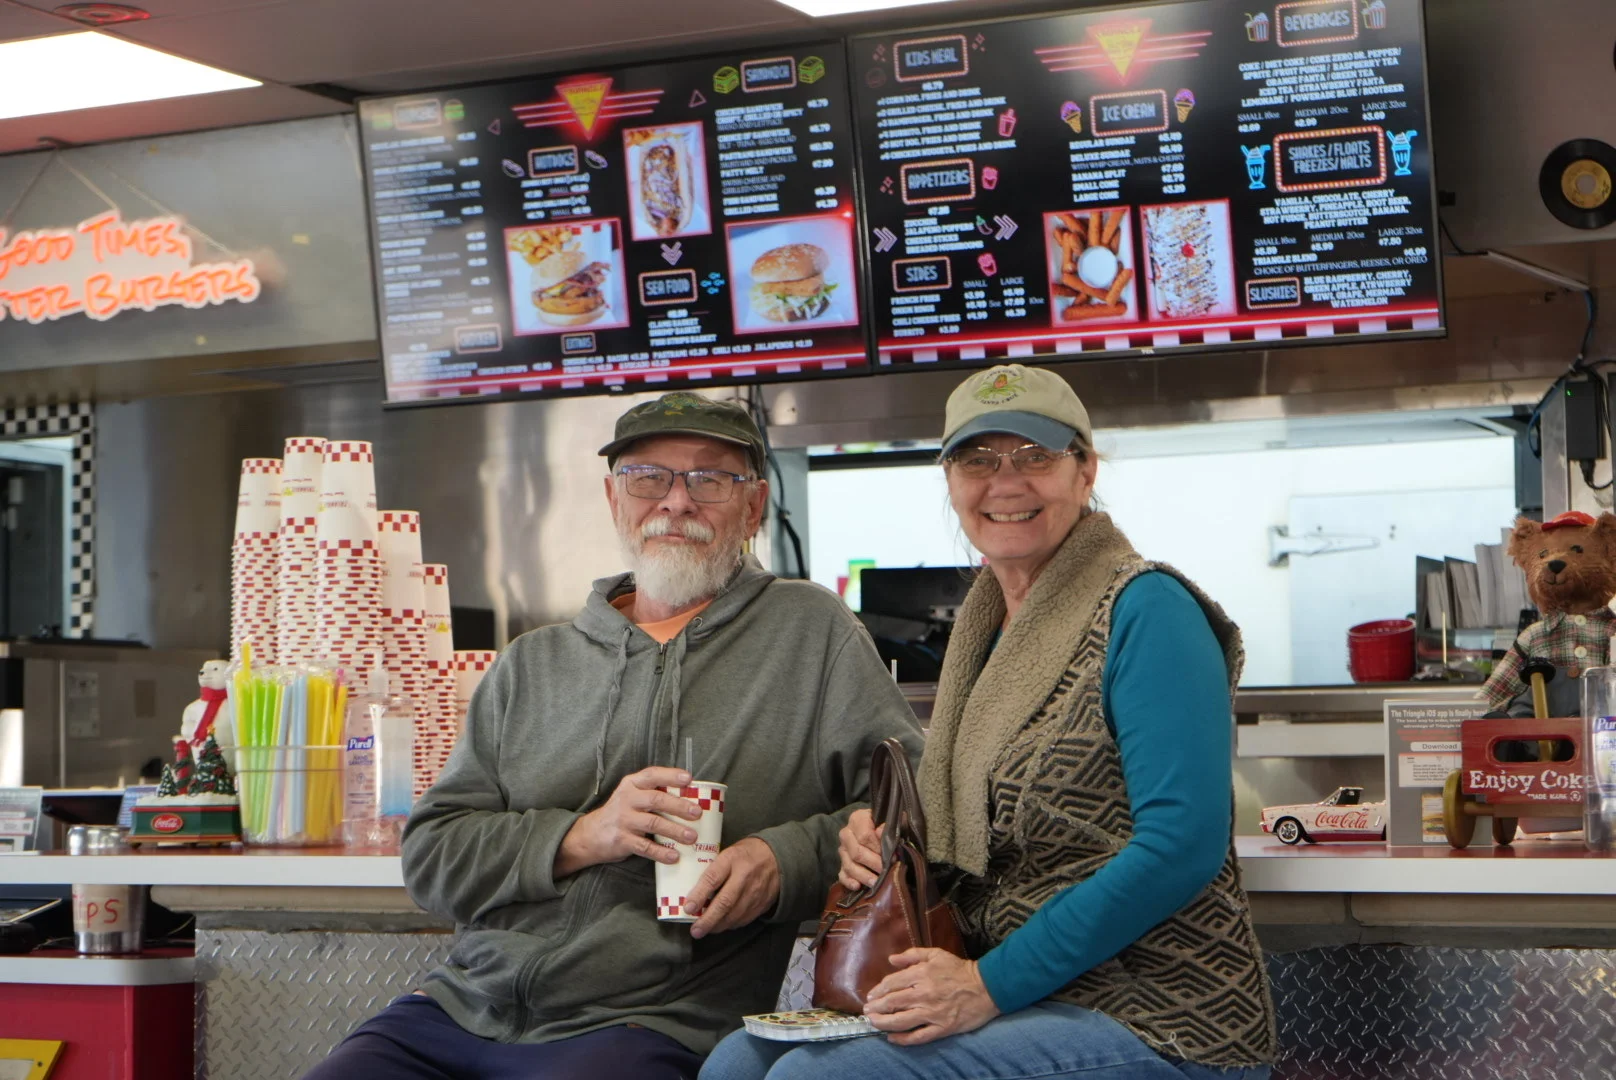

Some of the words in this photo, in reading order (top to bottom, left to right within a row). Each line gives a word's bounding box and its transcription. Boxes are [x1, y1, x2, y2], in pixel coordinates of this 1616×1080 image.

[1284, 10, 1350, 32] BEVERAGES
[905, 50, 931, 67] KIDS
[931, 47, 958, 65] MEAL
[1382, 57, 1399, 67] TEA
[1238, 62, 1261, 72] COKE
[1299, 74, 1326, 84] FANTA
[1331, 70, 1357, 81] GREEN
[1358, 69, 1375, 78] TEA
[1278, 86, 1294, 95] TEA
[1356, 77, 1384, 87] FANTA
[1241, 96, 1284, 108] LEMONADE
[1291, 91, 1336, 103] POWERADE
[1362, 101, 1388, 112] LARGE
[1102, 105, 1121, 122] ICE
[1121, 102, 1156, 120] CREAM
[1238, 113, 1265, 122] SMALL
[1295, 106, 1328, 118] MEDIUM
[1288, 144, 1326, 161] SHAKES
[1334, 140, 1371, 157] FLOATS
[1340, 154, 1372, 170] MALTS
[907, 170, 970, 189] APPETIZERS
[1362, 189, 1395, 200] CHERRY
[1366, 199, 1387, 208] ROOT
[1304, 220, 1336, 230] PEANUT
[1337, 217, 1368, 227] BUTTER
[1311, 232, 1344, 243] MEDIUM
[1378, 228, 1404, 237] LARGE
[1254, 238, 1280, 247] SMALL
[1252, 255, 1292, 266] TRIANGLE
[1254, 267, 1283, 277] CHOICE
[1284, 266, 1296, 274] OF
[1392, 257, 1403, 266] OR
[1405, 255, 1427, 265] OREO
[905, 266, 938, 283] SIDES
[85, 263, 256, 315] BURGERS
[645, 281, 665, 296] SEA
[963, 280, 987, 289] SMALL
[1000, 277, 1024, 286] LARGE
[1250, 285, 1297, 302] SLUSHIES
[1391, 709, 1402, 717] The
[1403, 709, 1425, 719] Triangle
[349, 738, 373, 749] Purell
[1469, 769, 1535, 795] Enjoy
[1540, 769, 1596, 789] Coke
